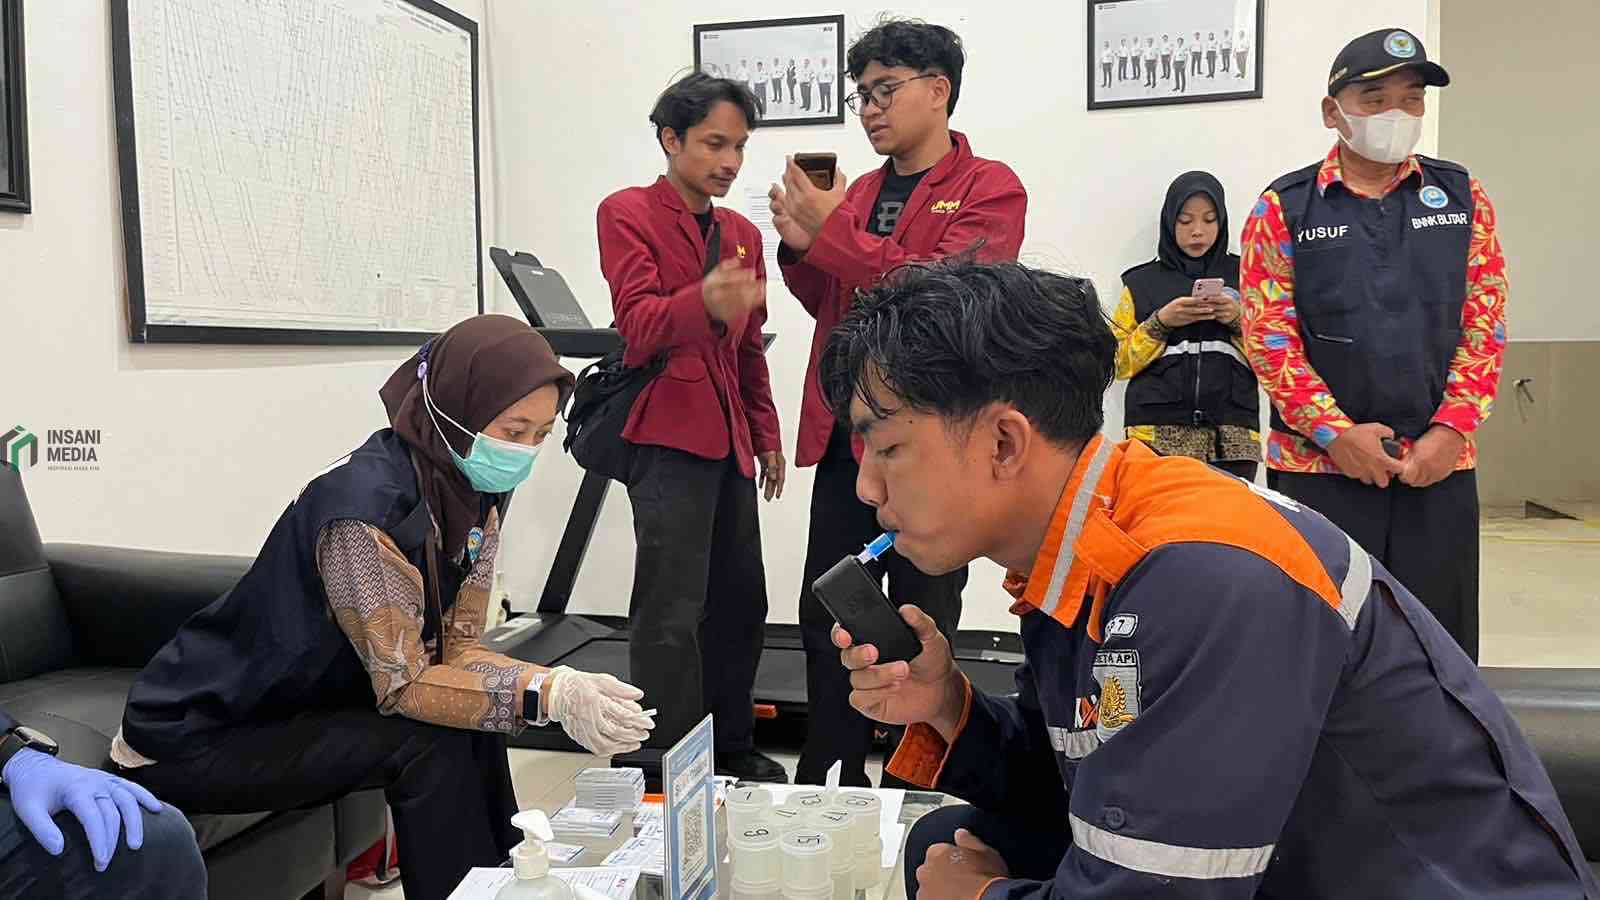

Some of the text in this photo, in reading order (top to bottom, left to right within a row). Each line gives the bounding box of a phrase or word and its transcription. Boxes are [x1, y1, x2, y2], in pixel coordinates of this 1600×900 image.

[1437, 213, 1468, 225] BLITAR
[1298, 225, 1349, 242] YUSUF
[1116, 653, 1135, 664] API
